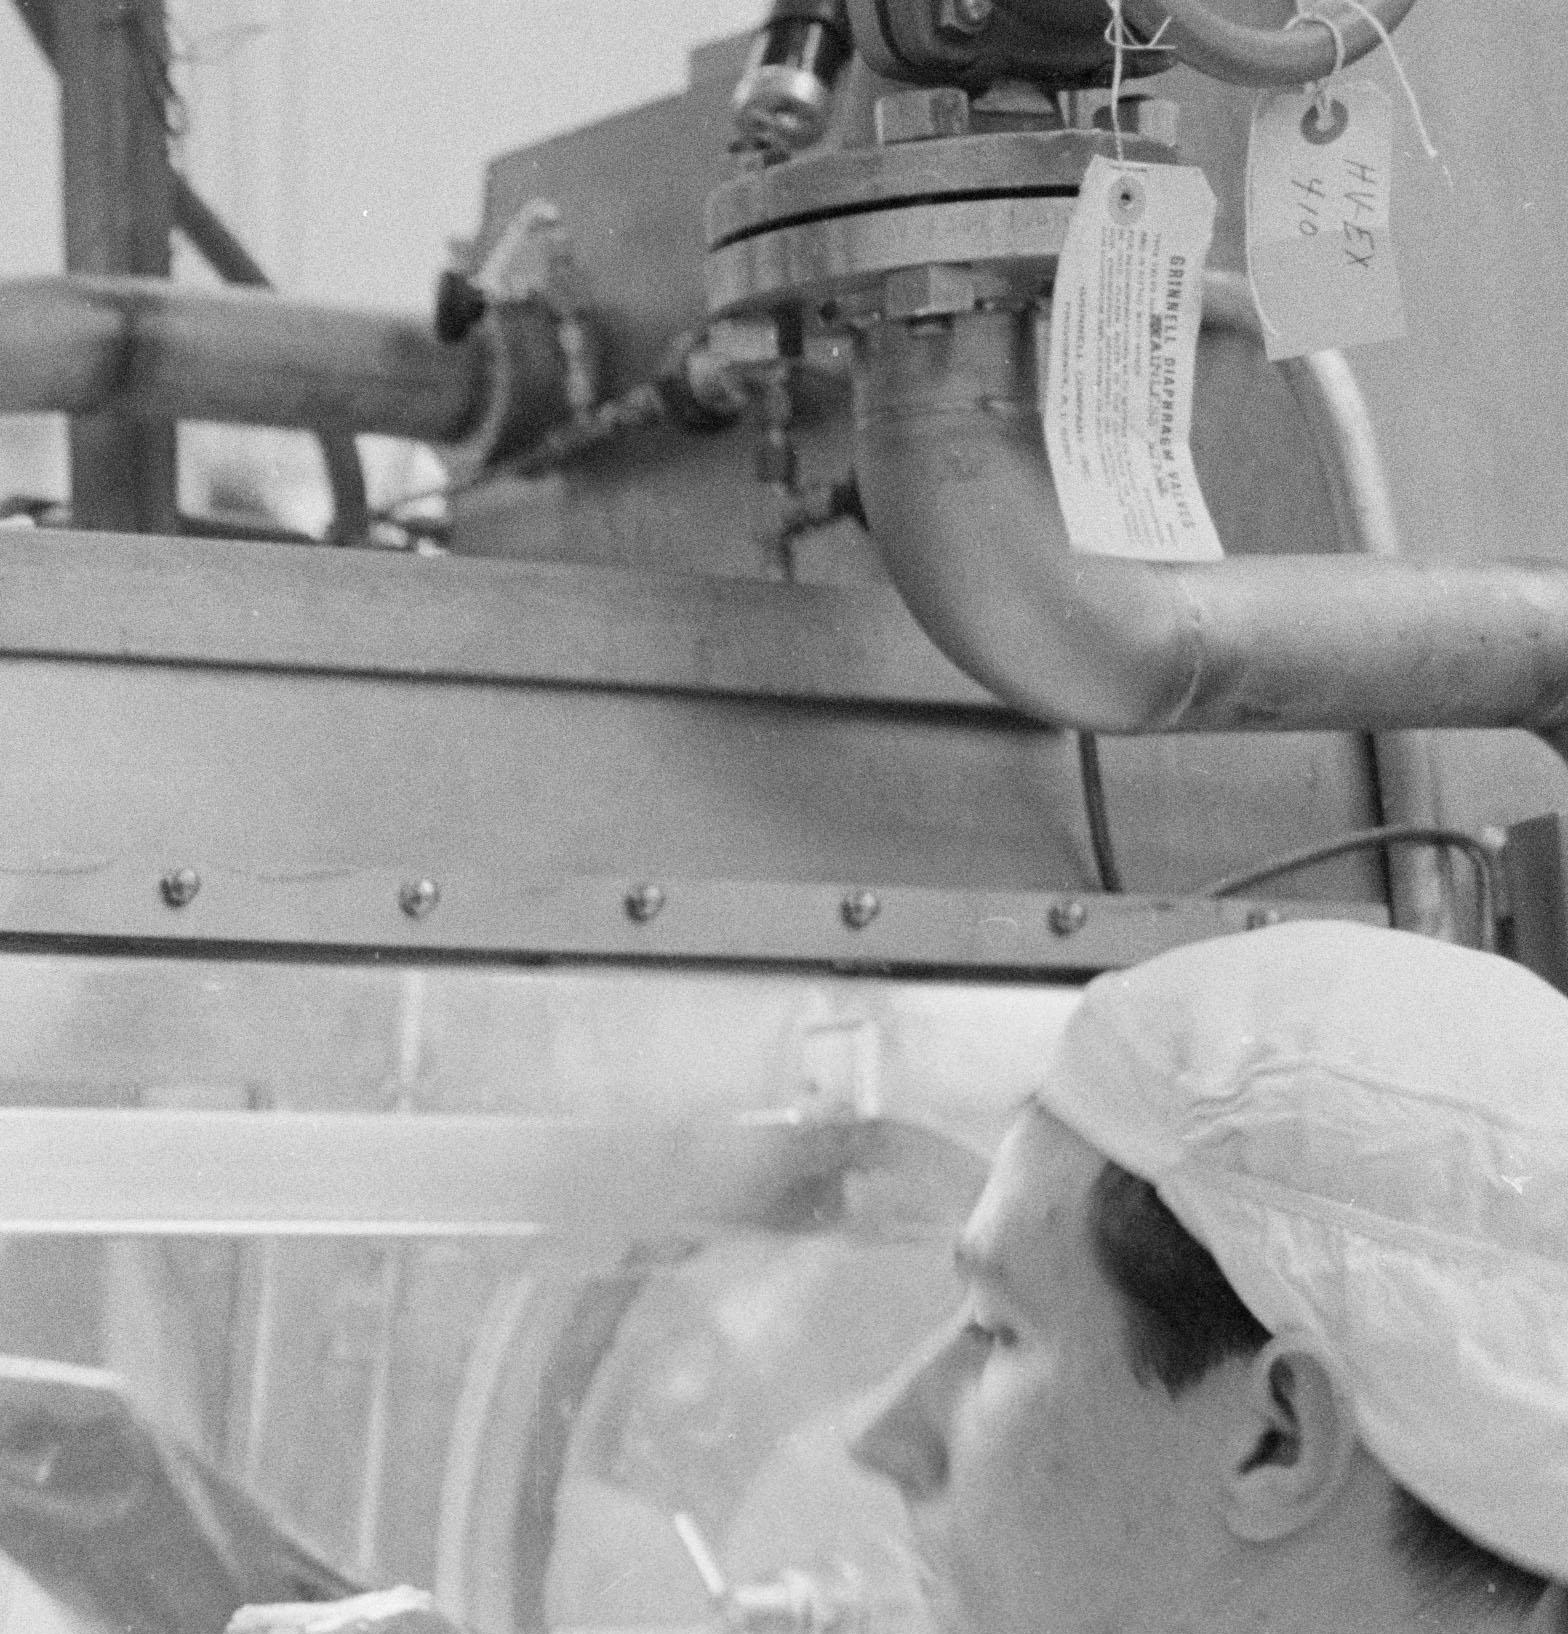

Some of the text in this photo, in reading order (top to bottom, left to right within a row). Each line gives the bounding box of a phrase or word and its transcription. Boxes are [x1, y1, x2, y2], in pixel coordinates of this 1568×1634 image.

[1290, 179, 1325, 237] 410
[1159, 255, 1195, 529] GRINNELL DIAPHRAGM VALVES
